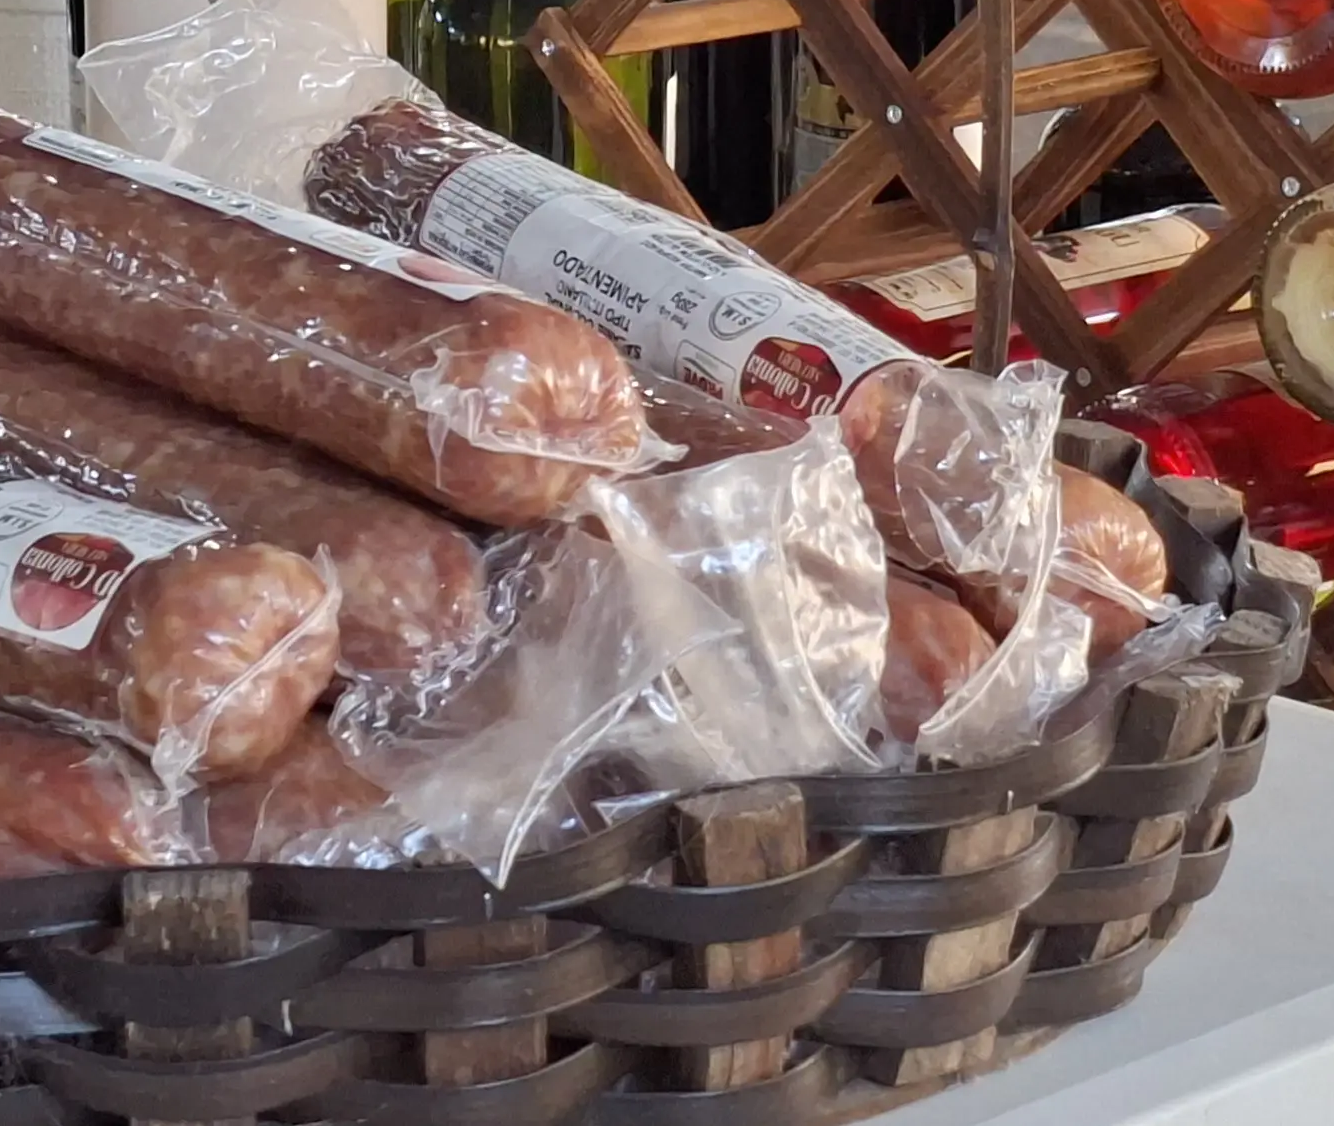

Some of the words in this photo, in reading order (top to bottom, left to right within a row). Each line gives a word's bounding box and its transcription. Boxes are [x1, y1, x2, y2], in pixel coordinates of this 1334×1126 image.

[553, 249, 650, 314] APIMENTADO
[605, 308, 631, 332] TIPO
[747, 354, 811, 410] Collonia
[21, 546, 98, 591] Collonia
